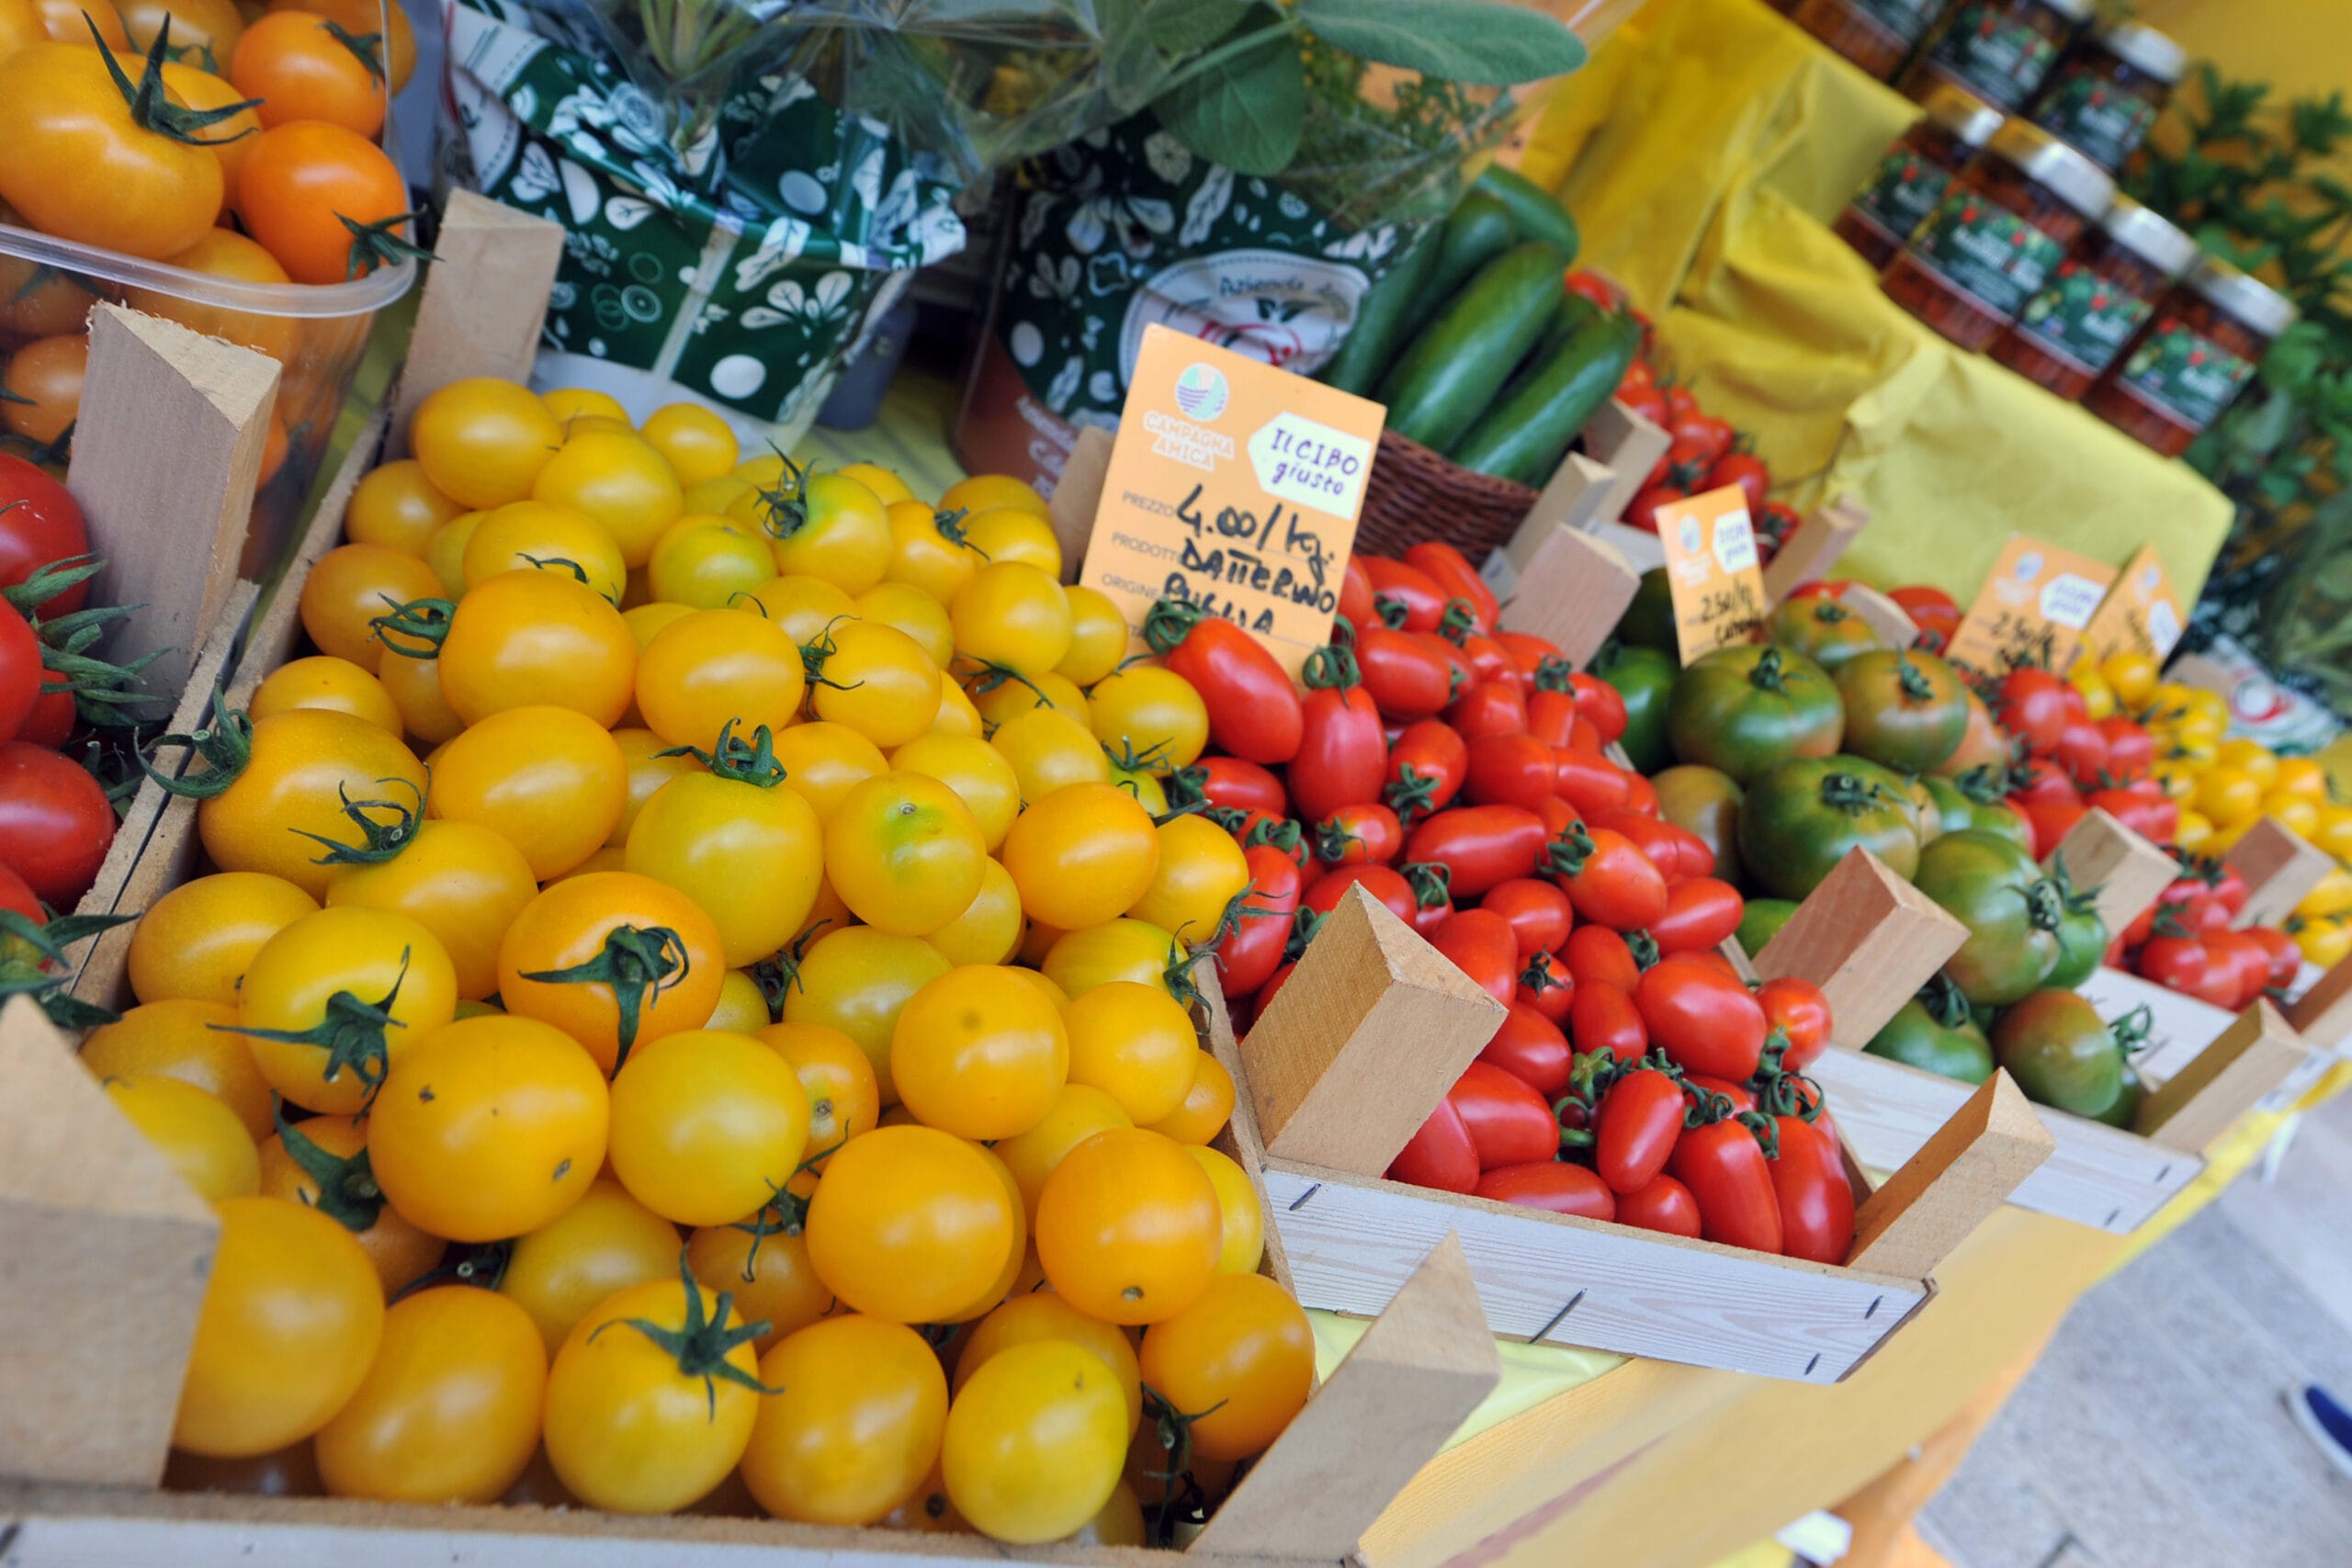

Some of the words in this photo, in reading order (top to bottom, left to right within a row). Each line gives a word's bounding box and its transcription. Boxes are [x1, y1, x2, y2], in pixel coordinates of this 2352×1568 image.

[1142, 410, 1235, 460] CAMPAGNA
[1151, 434, 1215, 472] AMICA
[1272, 460, 1345, 496] giusto
[1122, 491, 1175, 518] PREZZO
